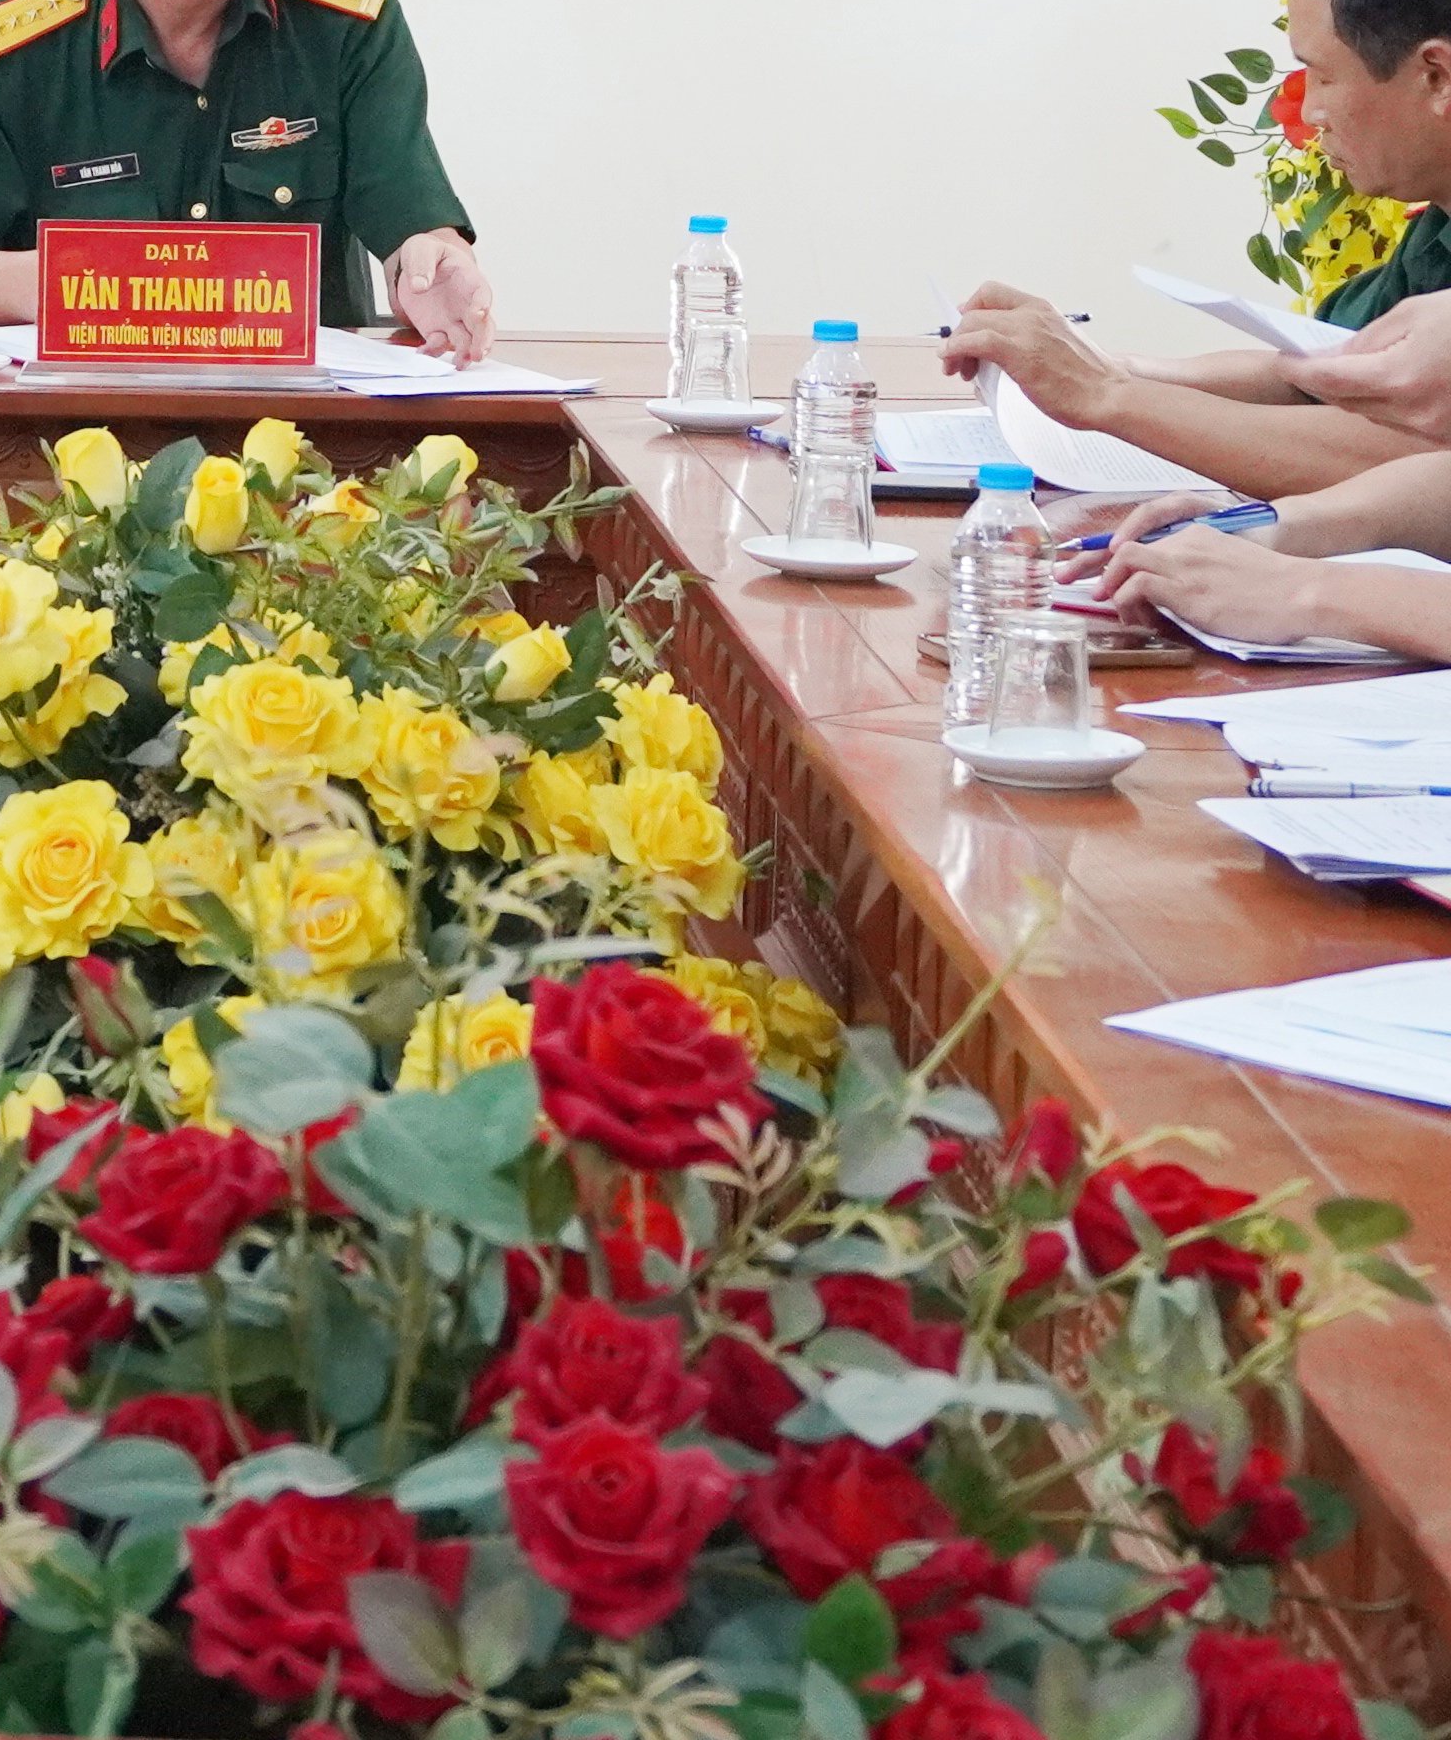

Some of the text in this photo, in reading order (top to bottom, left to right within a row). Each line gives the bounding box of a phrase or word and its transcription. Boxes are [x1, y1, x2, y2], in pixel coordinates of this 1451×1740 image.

[145, 241, 209, 266] ĐẠI TÁ
[61, 269, 292, 314] VĂN THANH HÒA
[68, 317, 282, 350] VIỆN TRƯỞNG VIỆN KSQS QUÂN KHU
